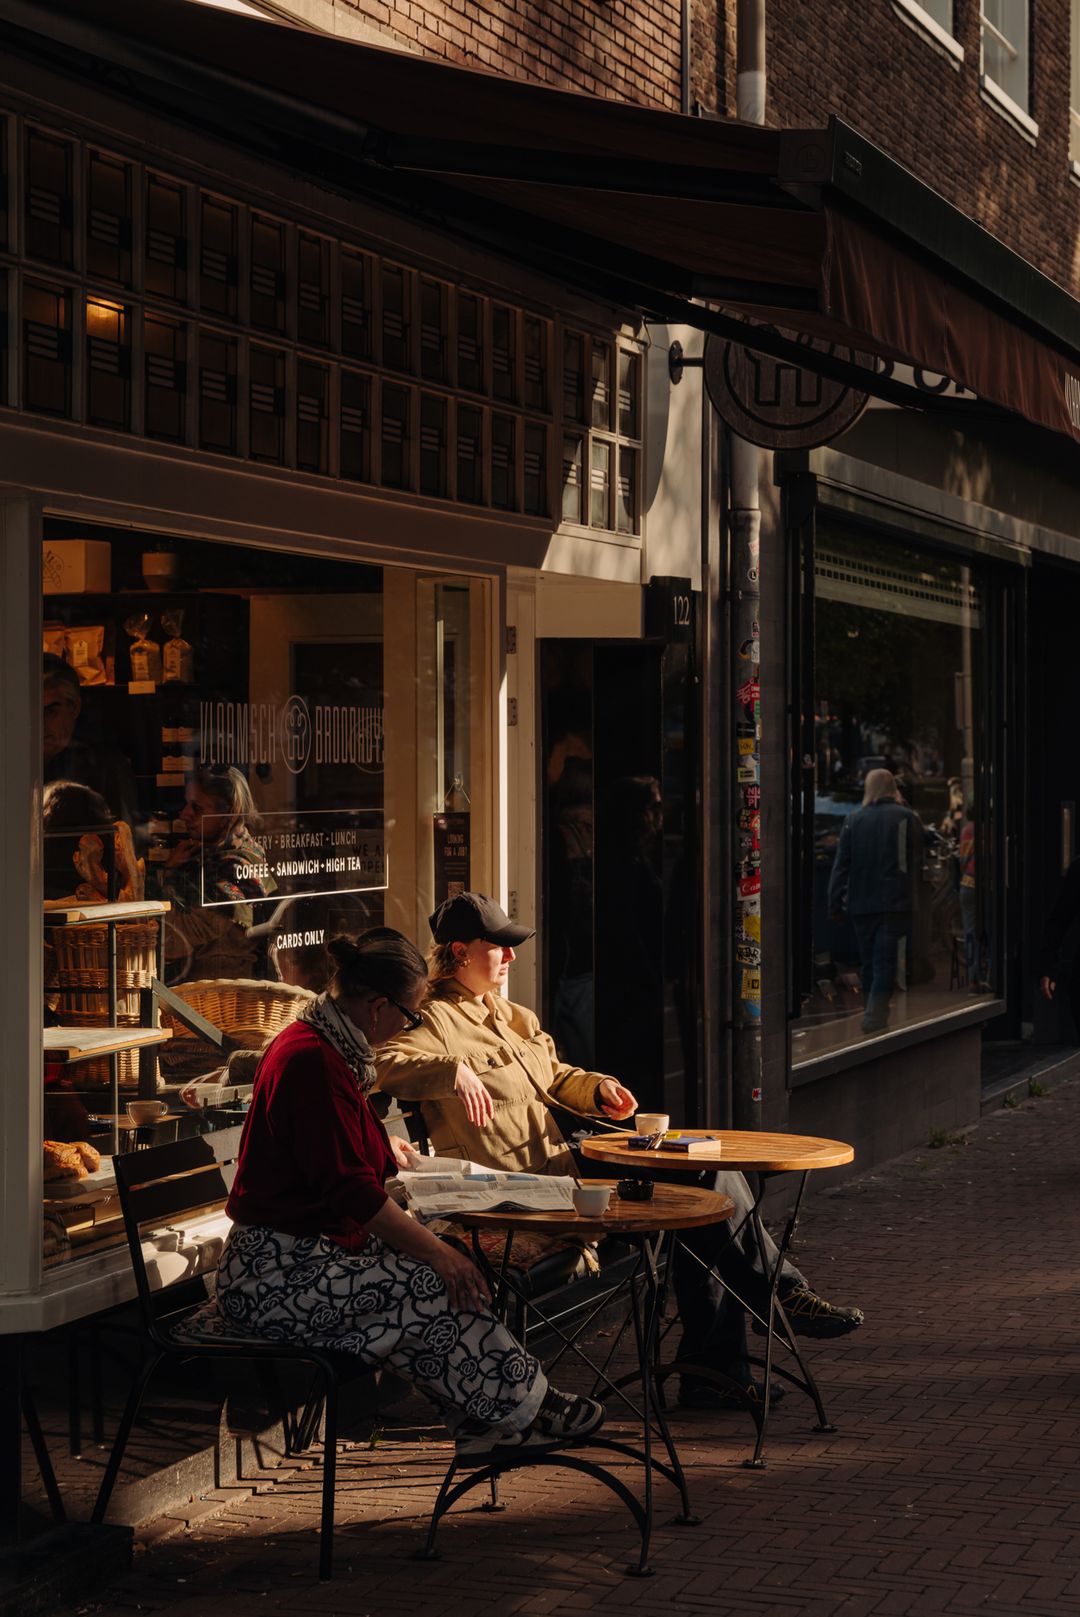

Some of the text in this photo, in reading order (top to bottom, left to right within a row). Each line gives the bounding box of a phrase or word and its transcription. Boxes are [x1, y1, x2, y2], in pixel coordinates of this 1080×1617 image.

[673, 595, 690, 625] 122
[200, 701, 276, 764] VLAAMSCH
[280, 832, 324, 849] BREAKFAST
[331, 831, 357, 846] LUNCH
[236, 856, 361, 880] COFFEE SANDWICH HIGH TEA
[361, 860, 384, 874] OPE
[277, 929, 325, 949] CARDS ONLY
